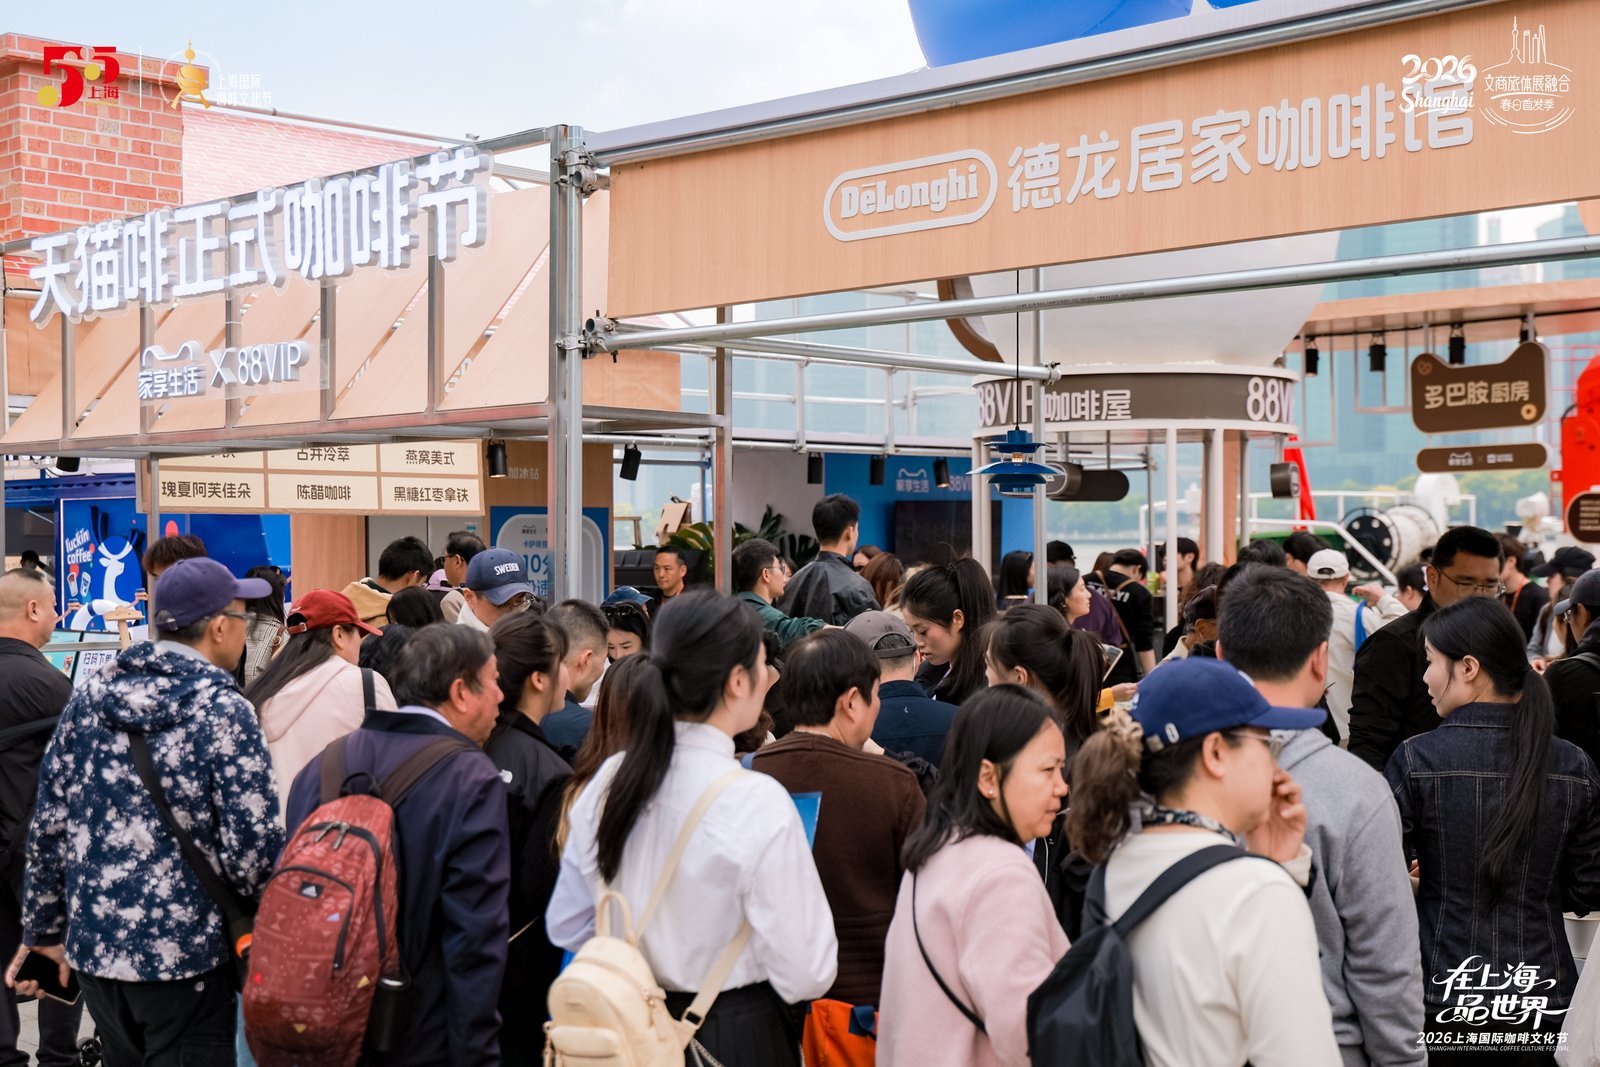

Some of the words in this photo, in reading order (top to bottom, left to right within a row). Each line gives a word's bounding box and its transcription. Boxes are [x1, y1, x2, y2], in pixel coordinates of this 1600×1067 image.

[1007, 80, 1474, 212] 德龙居家咖啡馆
[30, 148, 487, 322] 天猫啡正式咖啡节
[138, 366, 202, 400] 家享生活
[237, 341, 306, 387] 88VIP
[1044, 388, 1131, 422] 咖啡屋
[1424, 380, 1530, 409] 多巴胺厨房
[405, 449, 455, 466] 燕窝美式
[161, 481, 251, 499] 瑰夏阿芙佳朵
[296, 484, 351, 501] 陈醋咖啡
[394, 486, 469, 503] 黑糖红枣拿铁
[65, 528, 90, 553] luckin
[66, 547, 93, 566] coffee
[494, 562, 521, 576] SWEDEN
